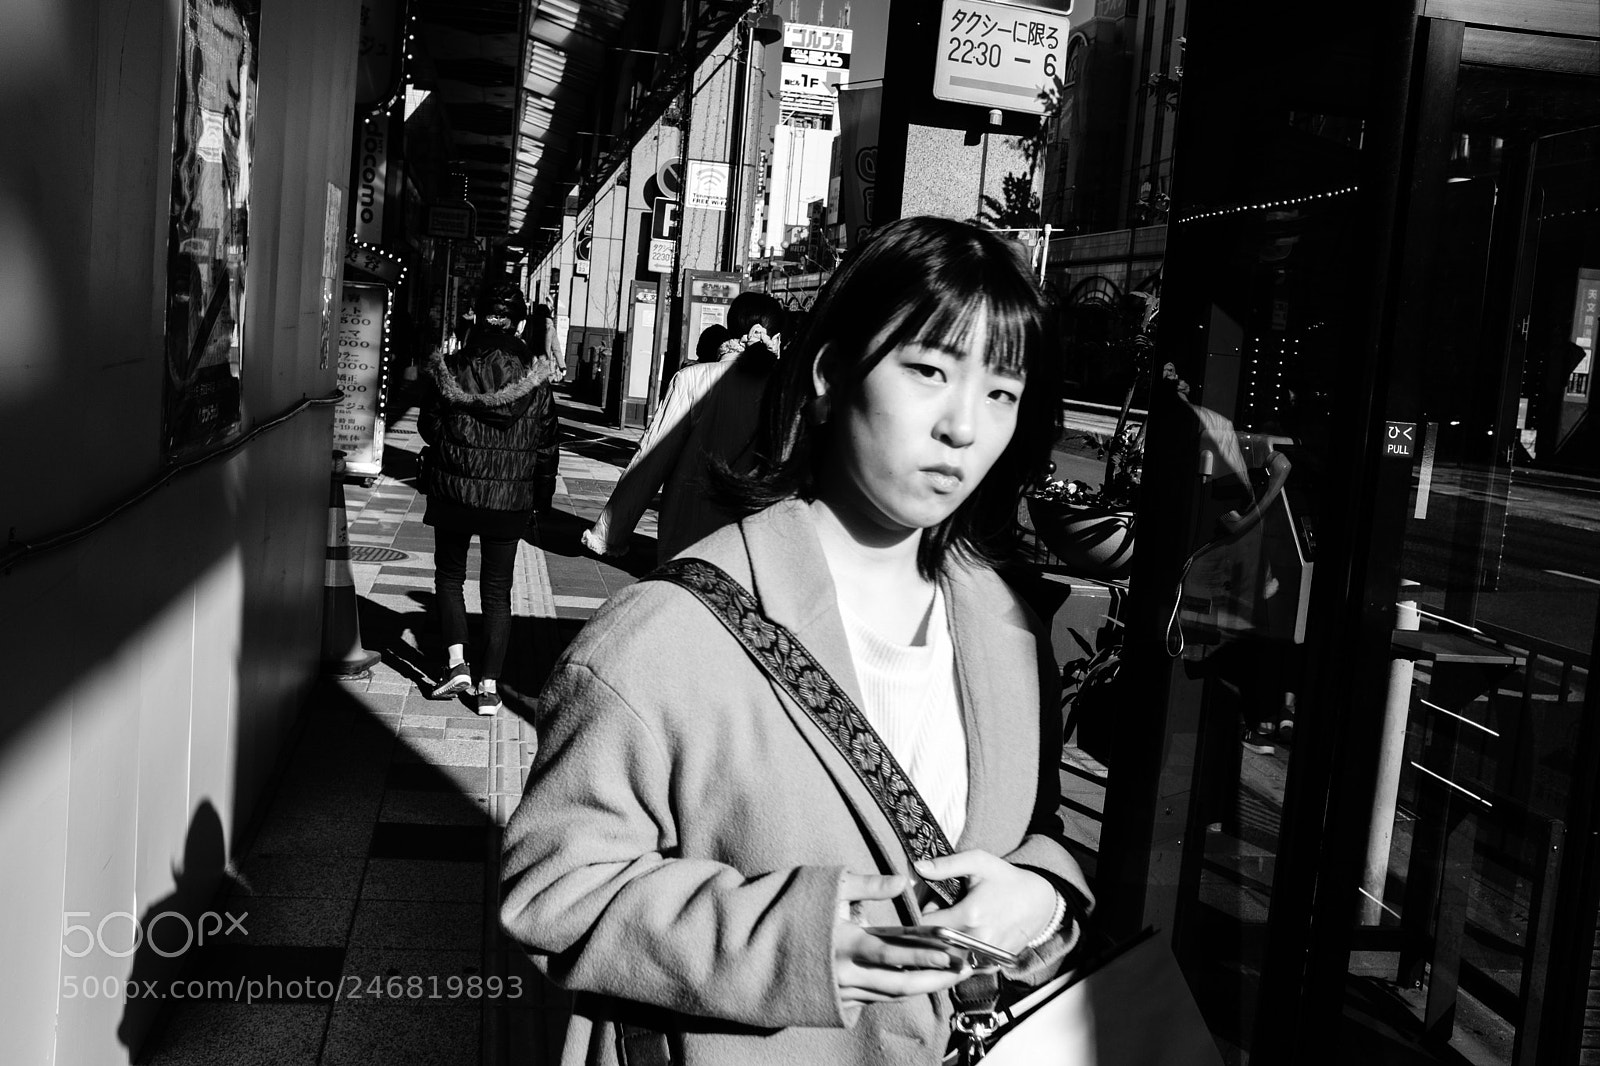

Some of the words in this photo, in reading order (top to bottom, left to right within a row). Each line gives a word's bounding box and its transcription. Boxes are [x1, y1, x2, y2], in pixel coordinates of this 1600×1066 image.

[950, 9, 1059, 49] タクシーに限る
[947, 37, 1002, 68] 22:30
[1043, 53, 1057, 77] 6
[801, 73, 819, 88] 1F
[360, 120, 383, 224] docomo
[1388, 426, 1412, 441] ひく
[1387, 444, 1410, 455] PULL
